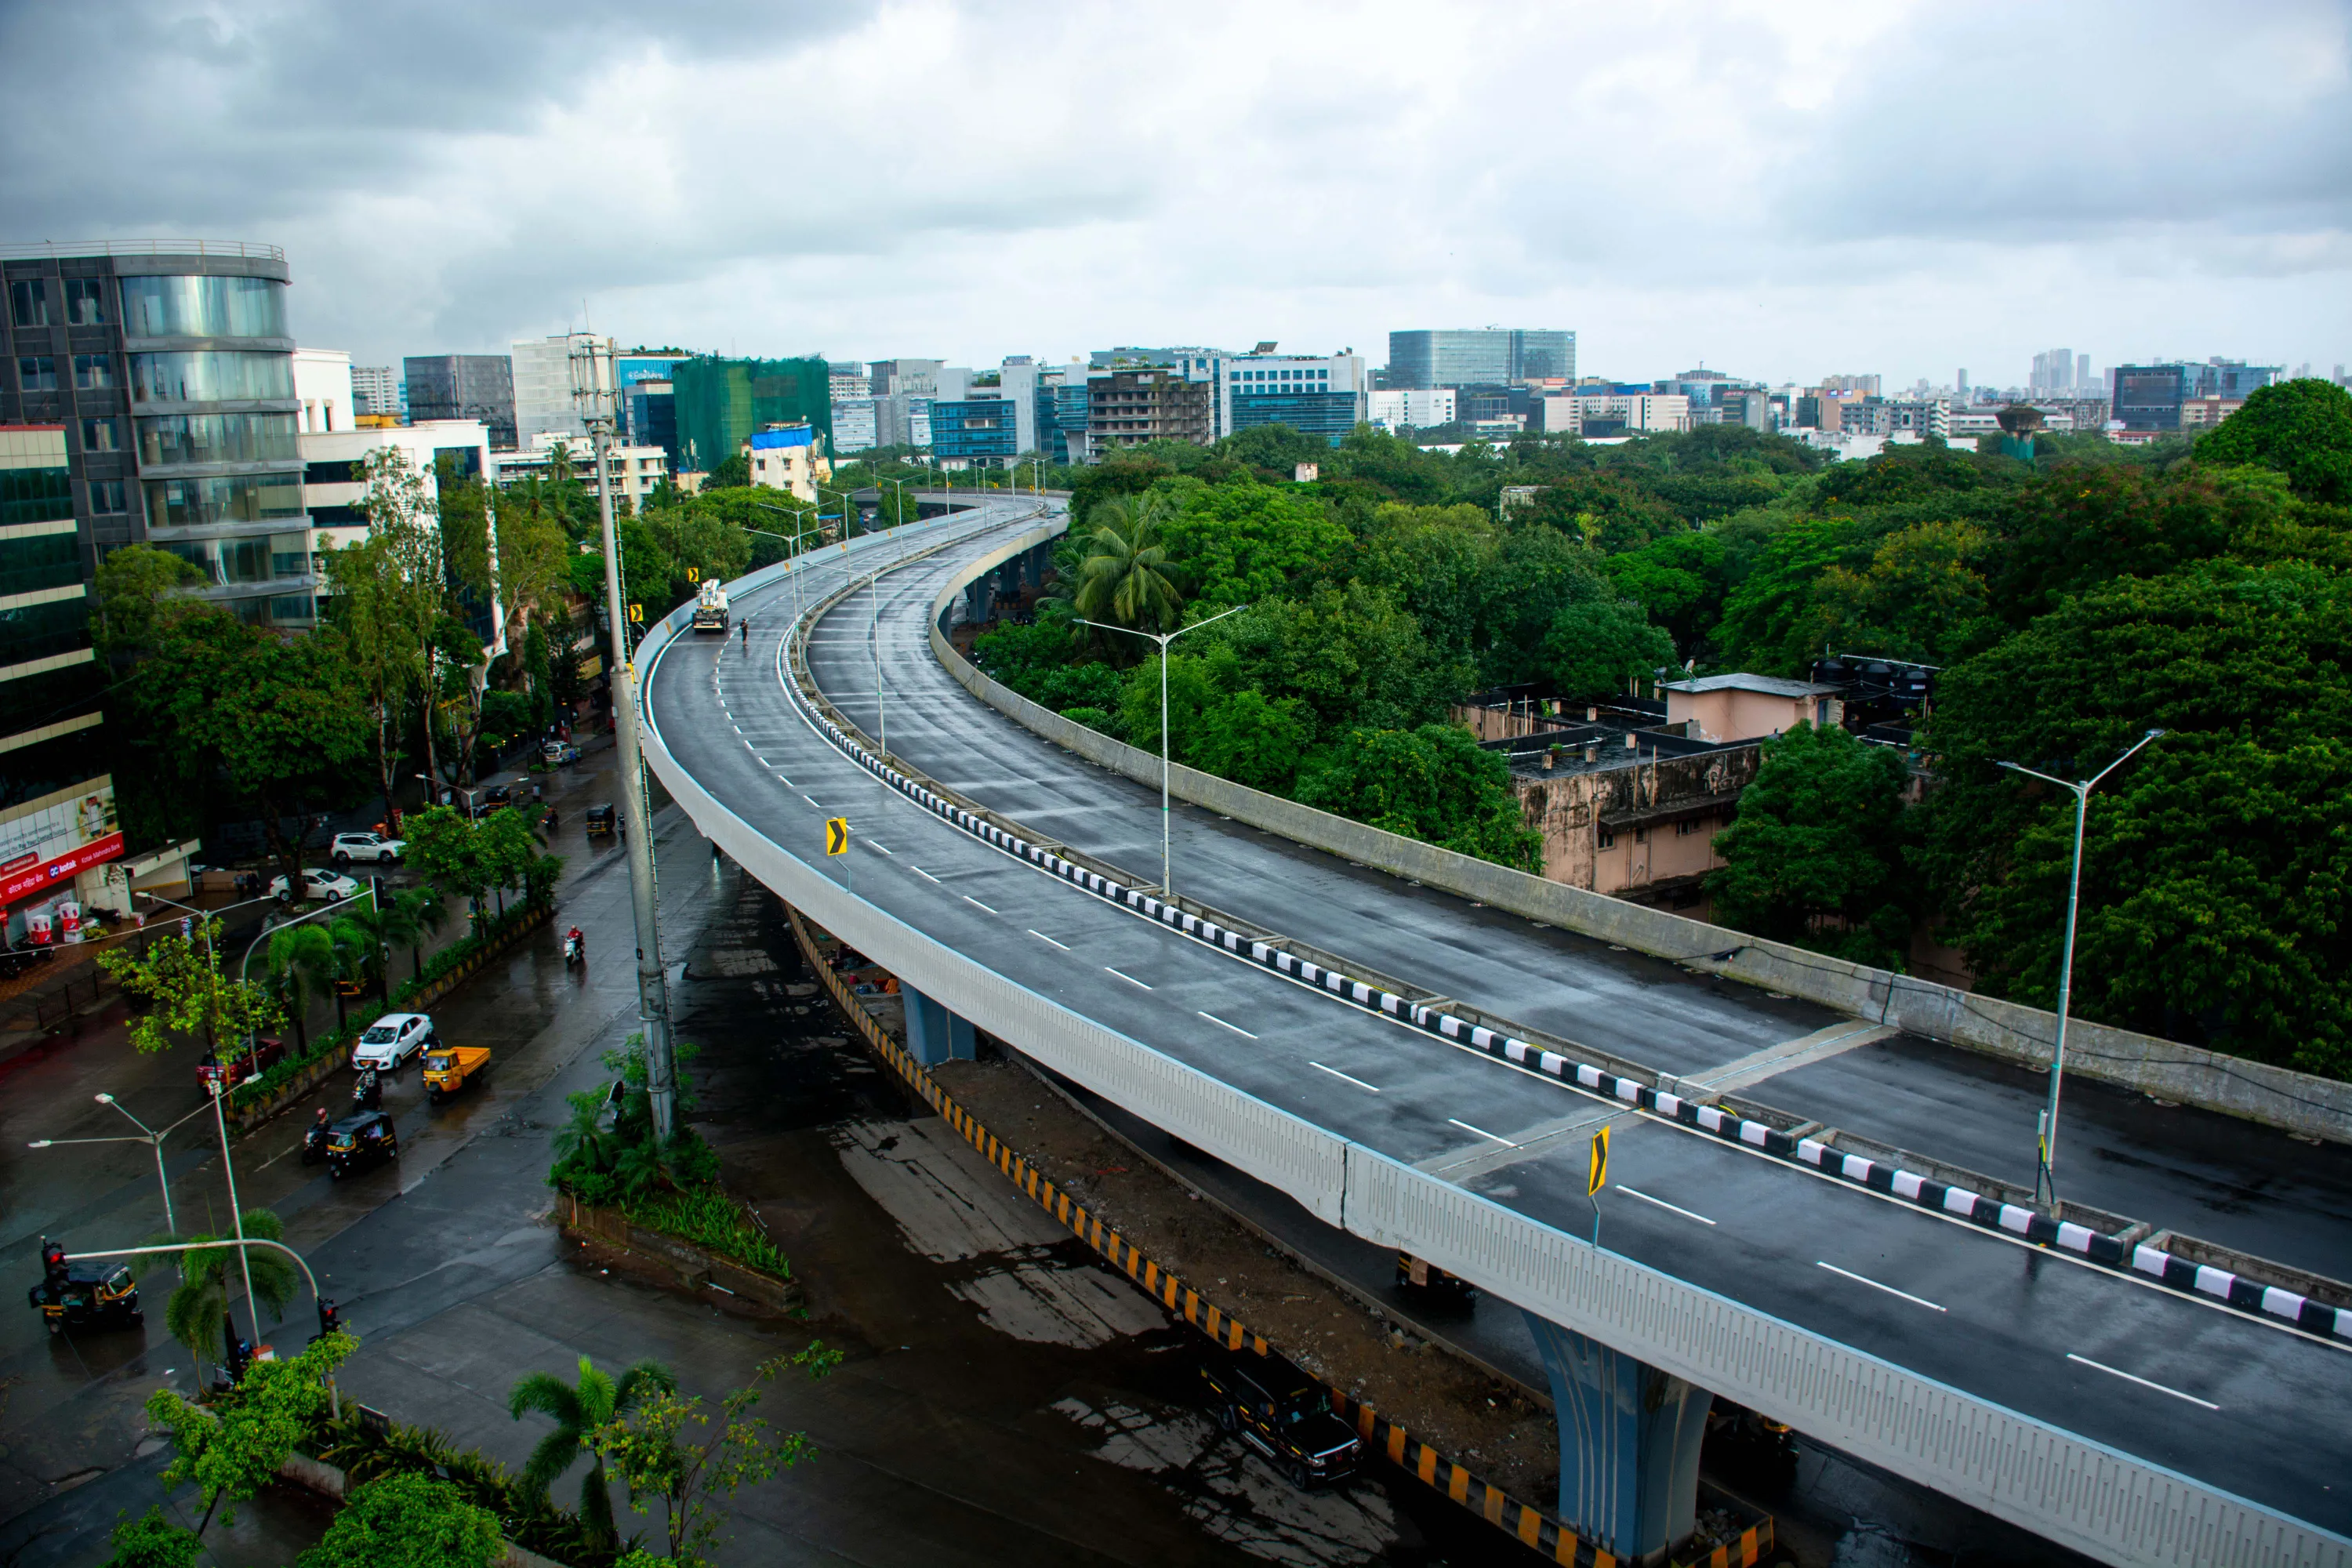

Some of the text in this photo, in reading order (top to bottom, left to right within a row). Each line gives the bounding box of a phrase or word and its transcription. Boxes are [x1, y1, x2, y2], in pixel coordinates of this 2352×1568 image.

[81, 843, 121, 864] Kotak Mahindra Bank
[59, 859, 77, 873] kotak
